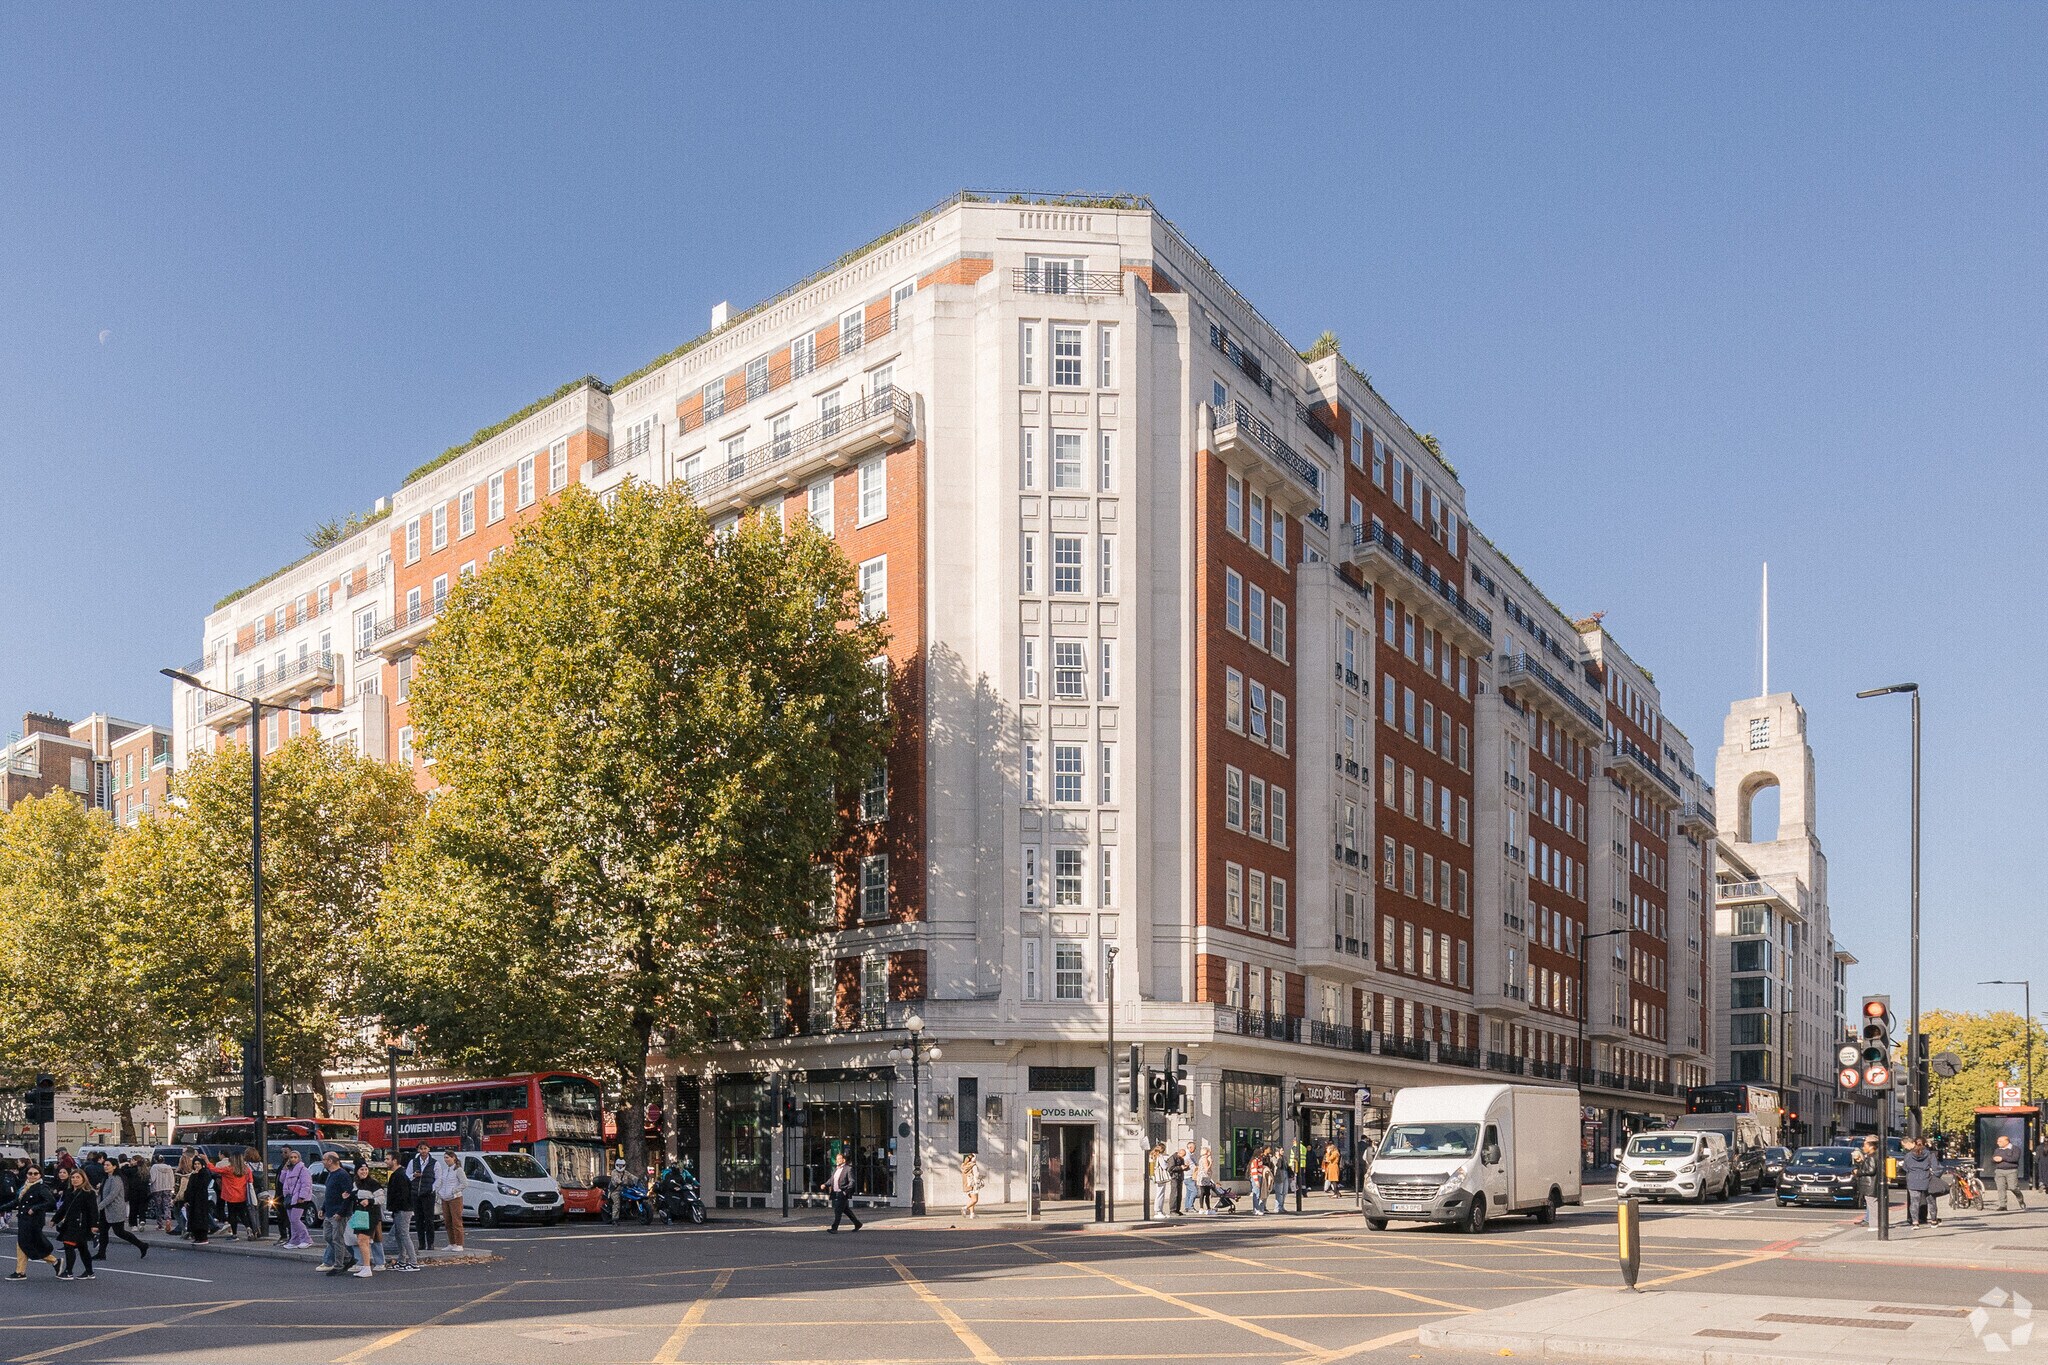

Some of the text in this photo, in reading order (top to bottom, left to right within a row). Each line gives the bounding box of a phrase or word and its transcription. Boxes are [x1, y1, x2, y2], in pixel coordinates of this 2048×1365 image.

[1307, 1087, 1346, 1101] TACO BELL
[1040, 1108, 1066, 1116] OYDS
[385, 1121, 457, 1134] HLOWEEN ENDS
